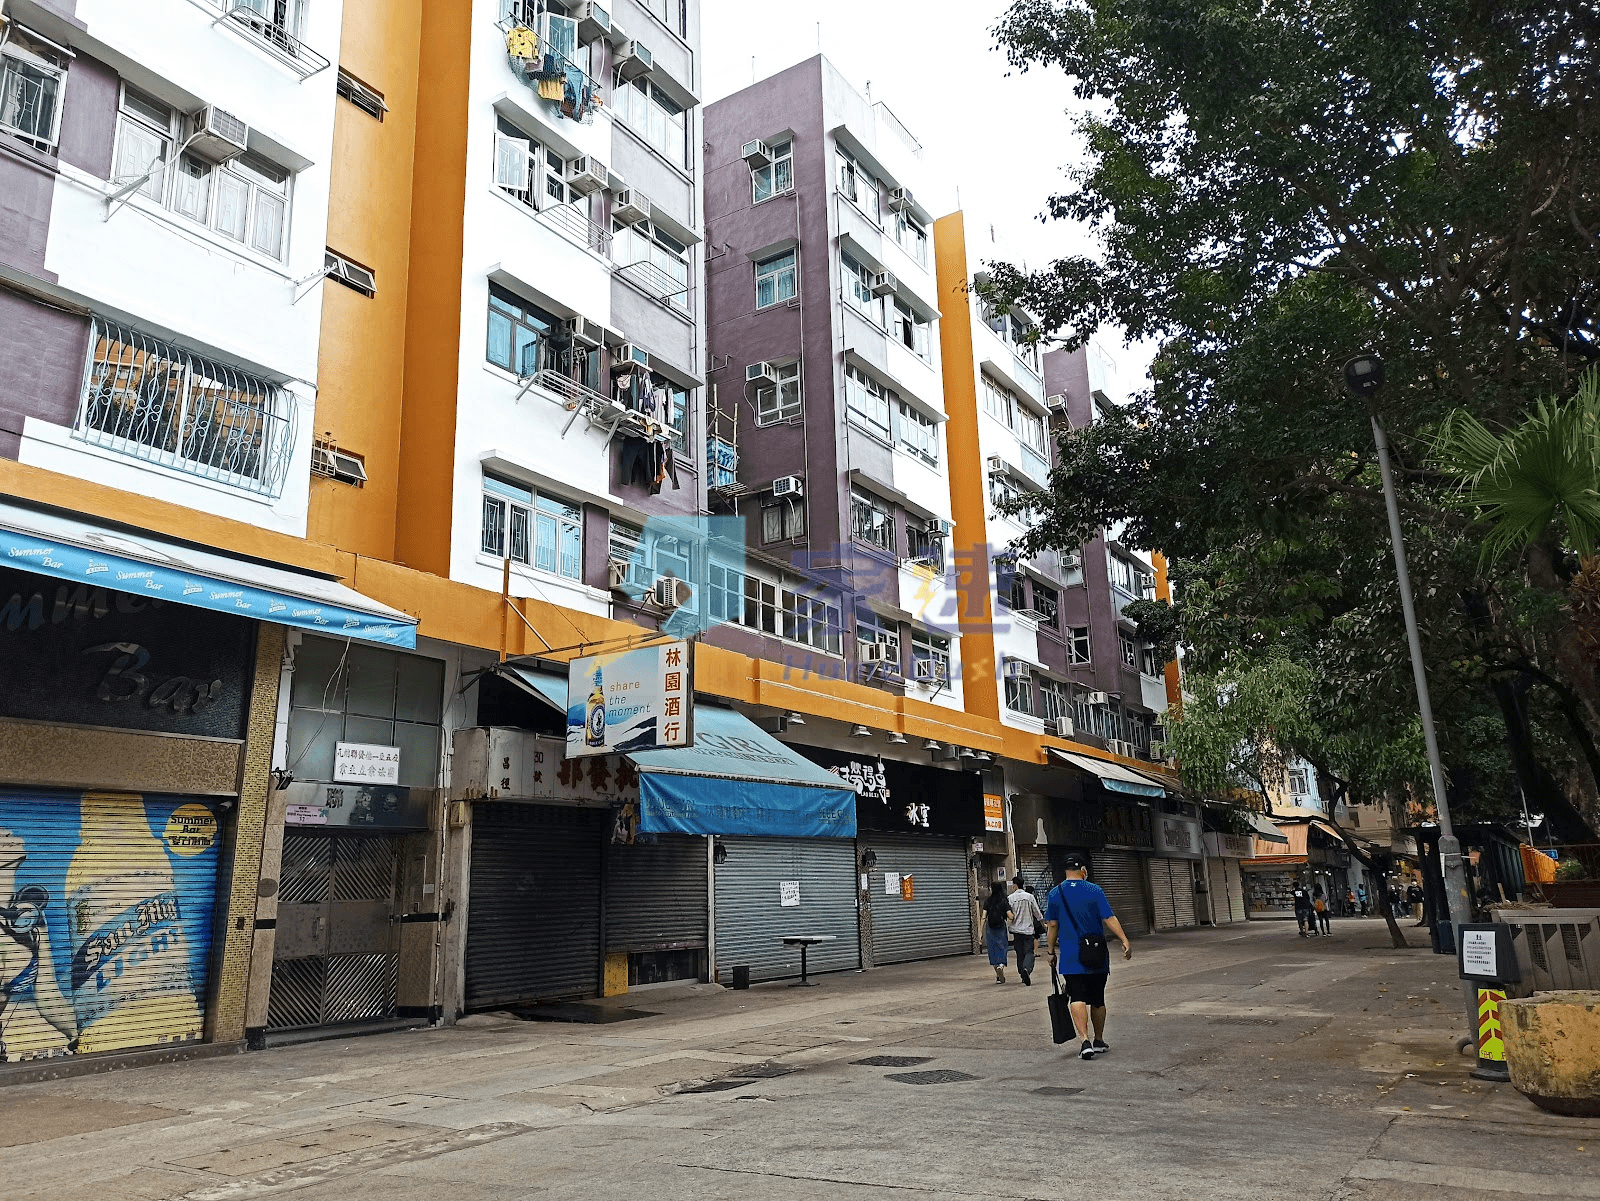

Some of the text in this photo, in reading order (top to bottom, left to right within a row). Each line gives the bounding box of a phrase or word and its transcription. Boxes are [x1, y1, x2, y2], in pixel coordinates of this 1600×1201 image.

[8, 547, 54, 557] Summer
[41, 557, 64, 569] Bar
[116, 570, 155, 580] Summer
[145, 579, 163, 591] Bar
[209, 591, 243, 600] Summer
[235, 599, 252, 609] Bar
[291, 608, 322, 617] Summer
[313, 615, 329, 625] Bar
[362, 623, 391, 633] Summer
[384, 630, 399, 639] Bar
[81, 642, 223, 712] Bar
[609, 681, 640, 692] share
[664, 647, 681, 741] 林園酒行
[609, 696, 626, 706] the
[608, 703, 651, 717] moment
[170, 815, 213, 824] Summer
[905, 802, 930, 827] 冰室
